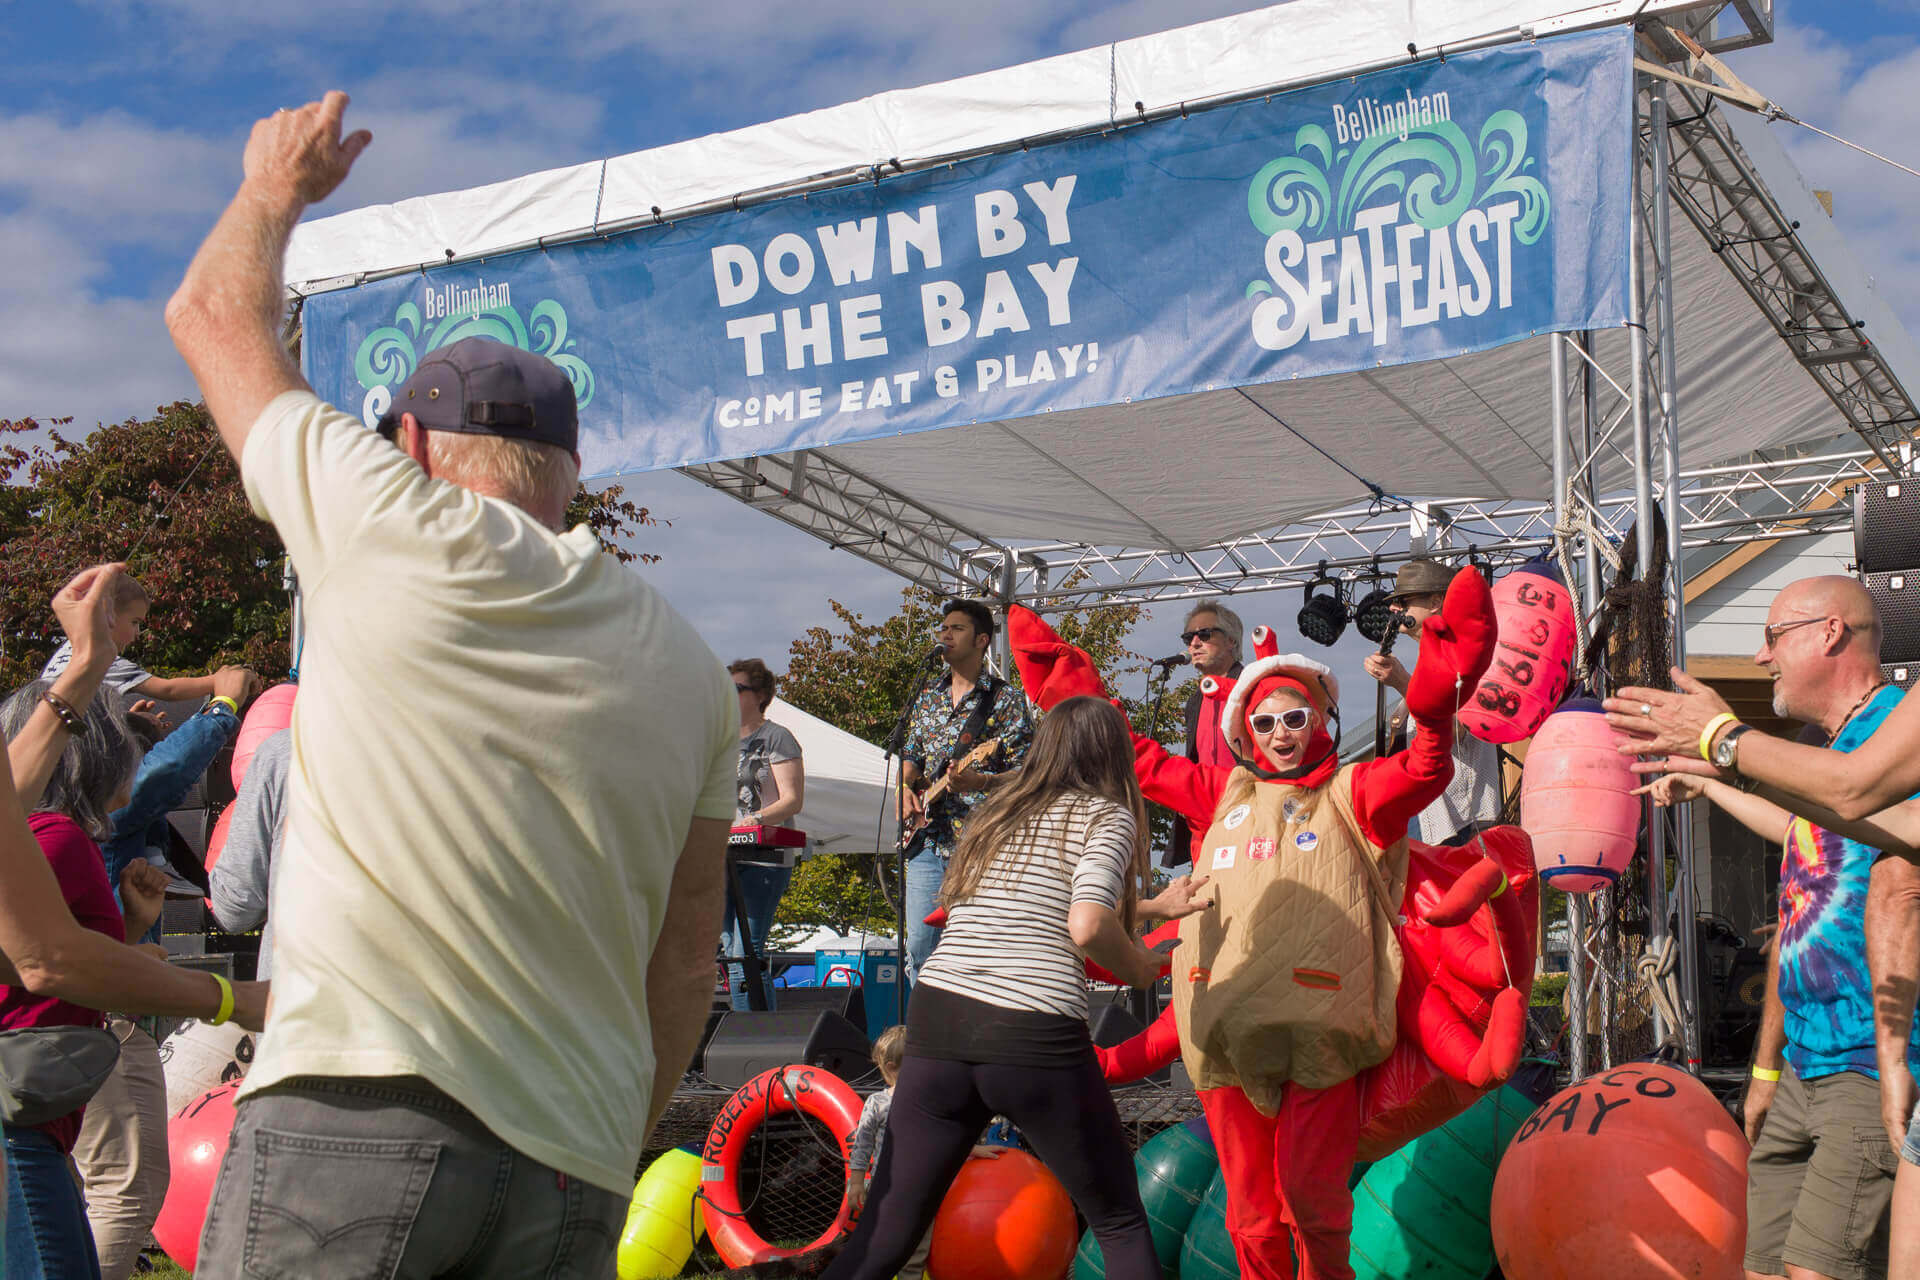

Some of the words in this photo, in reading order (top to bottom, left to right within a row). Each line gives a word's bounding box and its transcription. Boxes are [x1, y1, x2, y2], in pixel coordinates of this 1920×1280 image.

[1332, 88, 1451, 144] Bellingham
[711, 204, 943, 307] DOWN
[973, 174, 1077, 259] BY
[1251, 200, 1520, 351] SEAFEAST
[424, 278, 512, 320] Bellingham
[726, 293, 889, 377] THE
[920, 256, 1079, 347] BAY
[839, 370, 920, 413] EAT
[934, 365, 960, 398] &
[975, 342, 1099, 392] PLAY!
[728, 833, 748, 845] ctro
[703, 1076, 766, 1164] ROBERT
[1517, 1091, 1632, 1144] BAY
